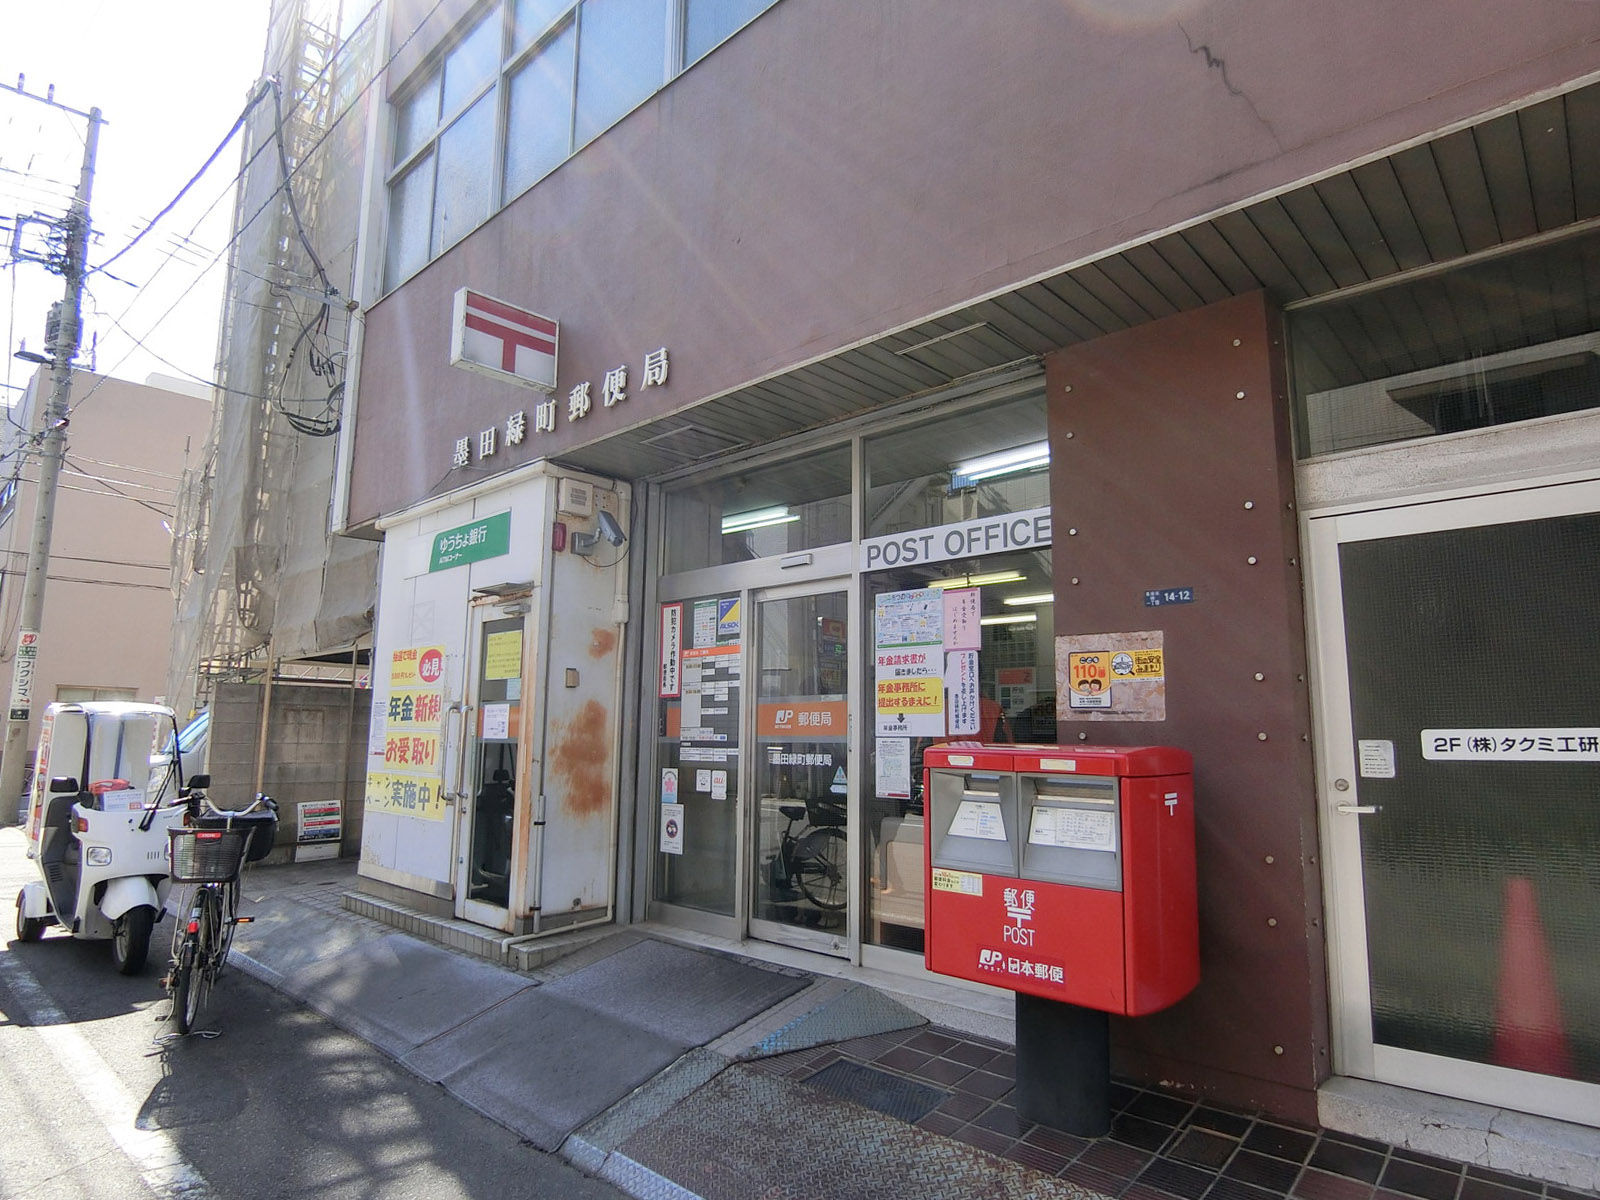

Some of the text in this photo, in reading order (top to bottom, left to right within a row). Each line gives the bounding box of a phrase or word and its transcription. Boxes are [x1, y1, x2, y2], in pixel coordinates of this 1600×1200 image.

[453, 347, 670, 467] 墨田緑町郵便局
[440, 525, 487, 554] ゆうちょ銀行
[867, 515, 1052, 568] POST OFFICE
[1164, 591, 1190, 601] 14-12
[878, 653, 926, 666] 年金請求書が
[18, 661, 31, 697] フクシマ
[878, 682, 926, 693] 年金事務所に
[798, 712, 832, 726] 郵便局
[772, 753, 832, 766] 墨田緑町郵便局
[1003, 888, 1035, 911] 郵便
[1003, 925, 1035, 947] POST
[1008, 957, 1064, 983] 日本郵便
